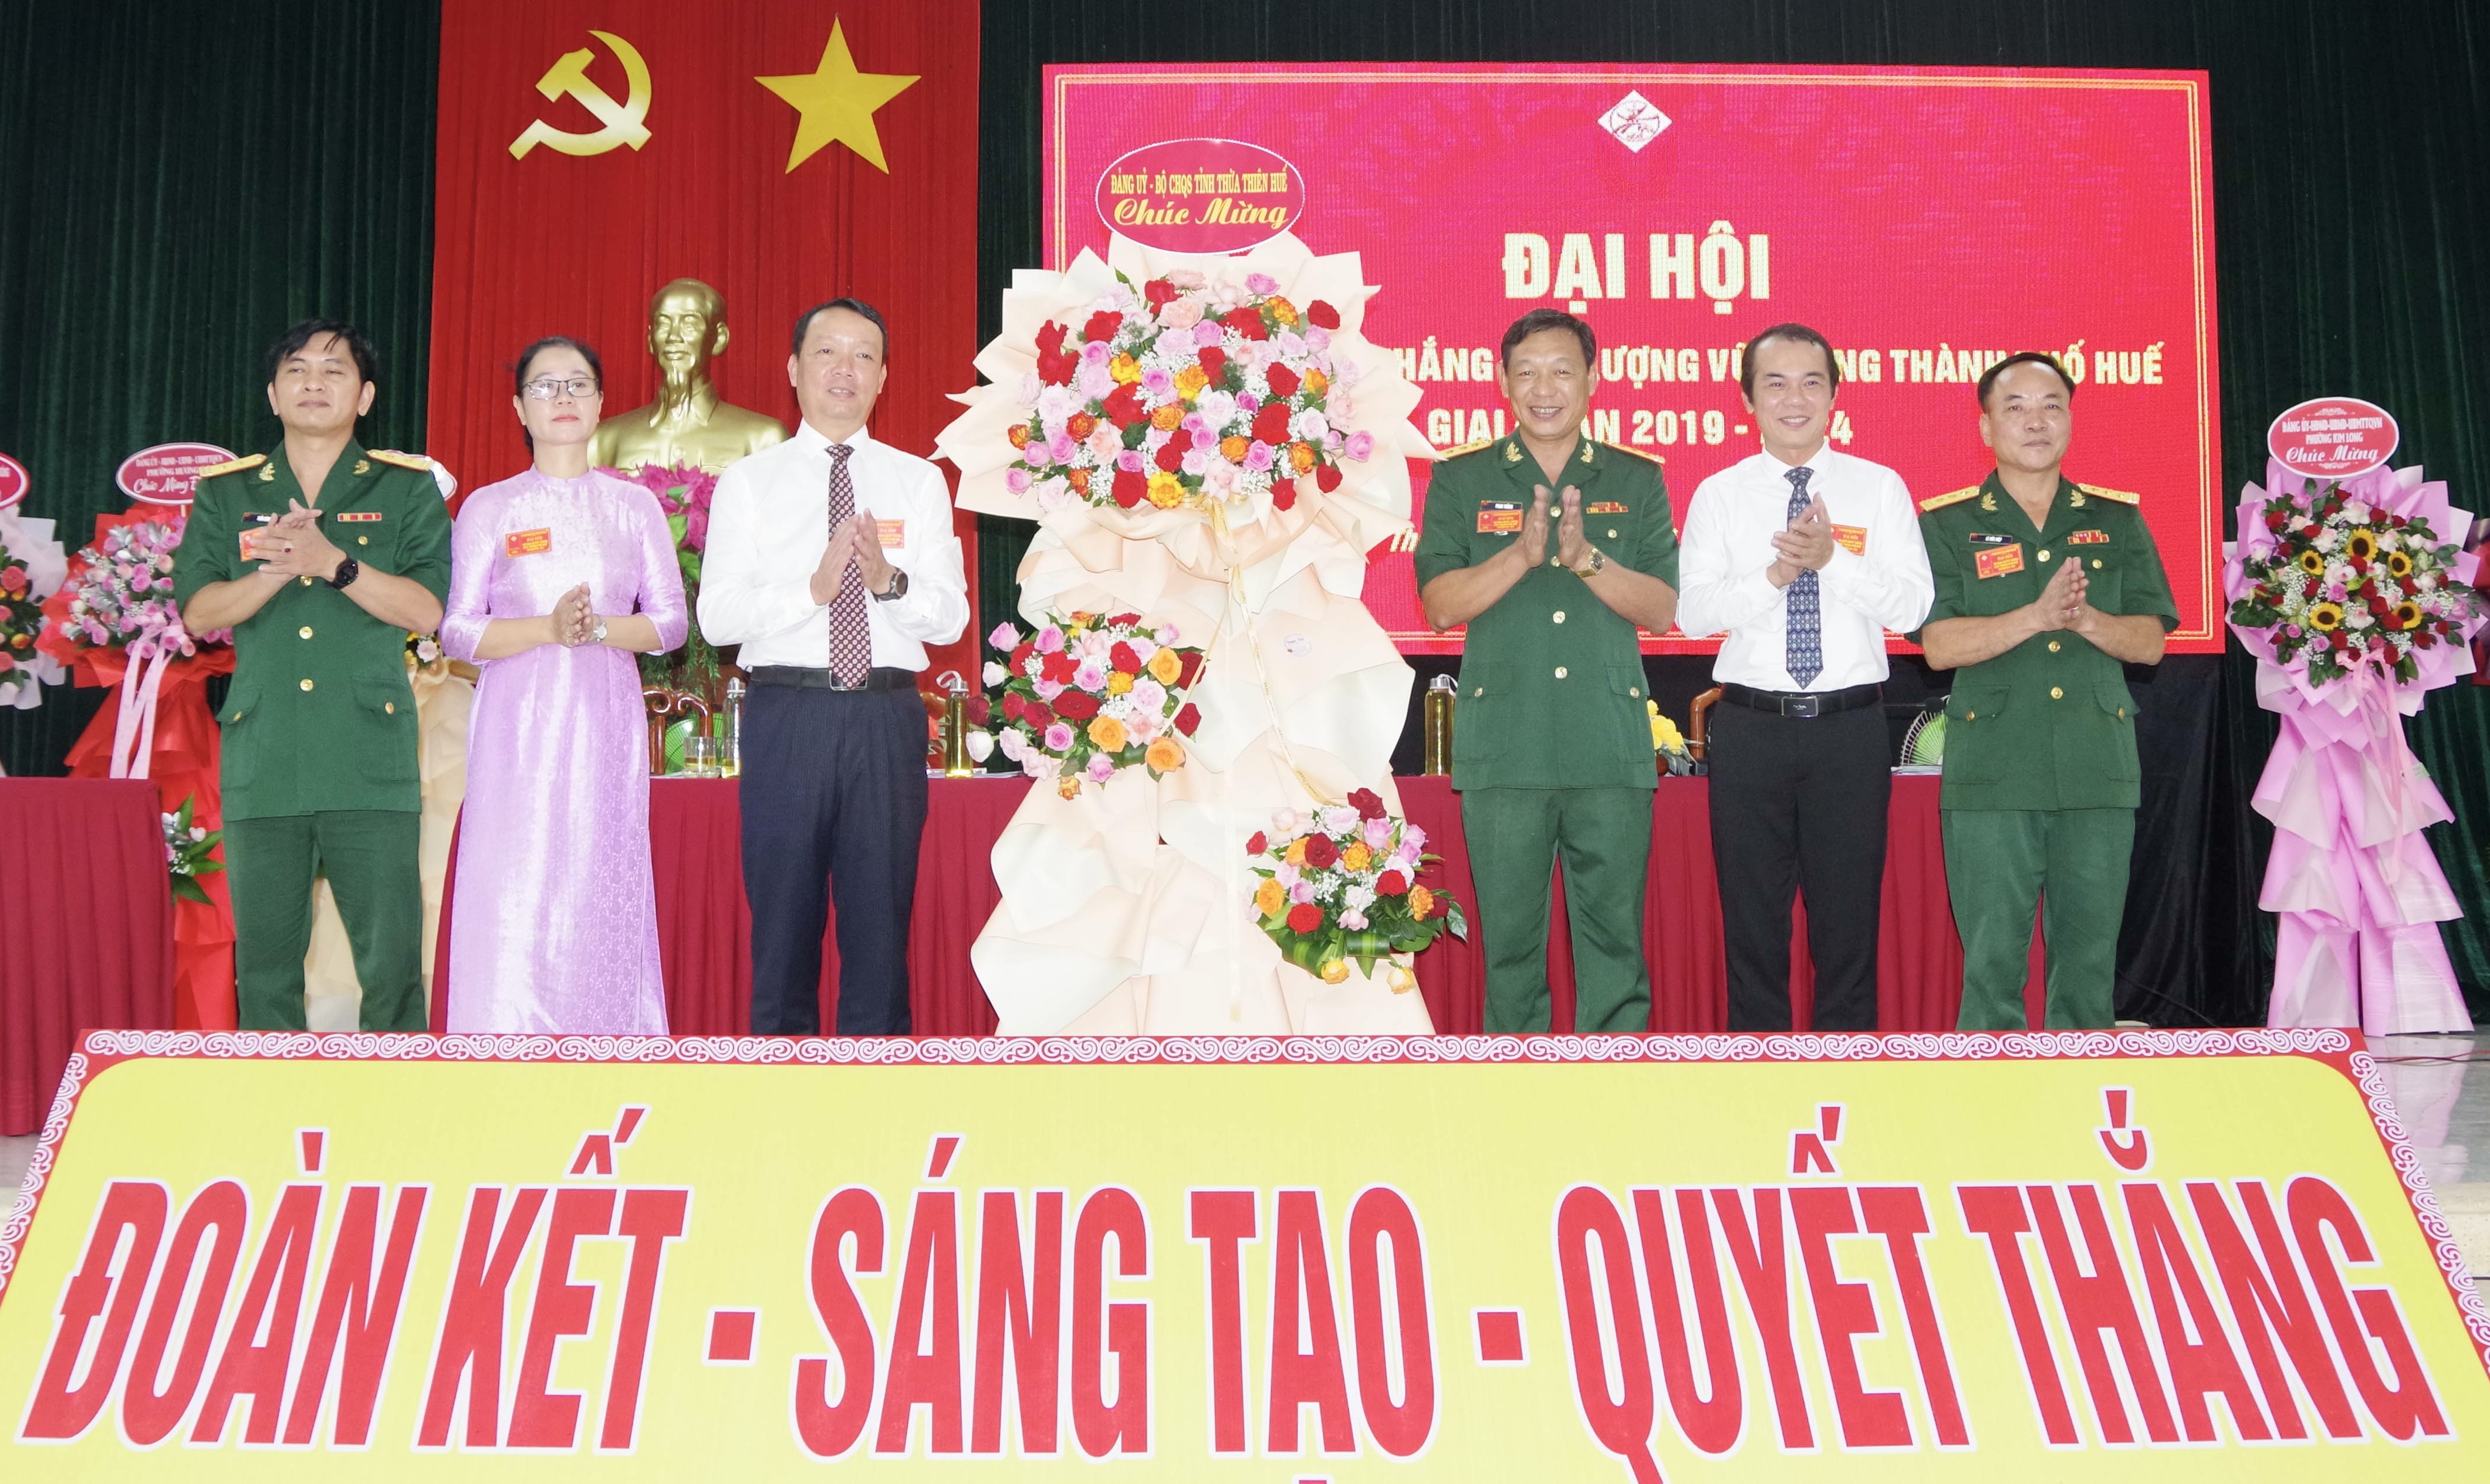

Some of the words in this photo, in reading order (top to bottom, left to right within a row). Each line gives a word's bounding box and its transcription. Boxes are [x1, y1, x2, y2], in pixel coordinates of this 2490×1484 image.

[1111, 167, 1134, 194] ĐẢNG
[1155, 169, 1167, 199] BỘ
[1169, 174, 1192, 199] CHQS
[1194, 167, 1215, 194] TỈNH
[1217, 168, 1241, 194] THỪA
[1242, 168, 1268, 194] THIÊN
[1270, 164, 1288, 192] HUẾ
[1114, 198, 1190, 225] Chúc
[1195, 198, 1289, 229] Mừng
[1502, 232, 1625, 314] ĐẠI
[1649, 220, 1769, 315] HỘI
[1388, 335, 1494, 382] HẮNG
[1597, 345, 1700, 390] ƯỢNG
[2094, 341, 2165, 385] HUẾ
[1427, 408, 1505, 445] GIAI
[1631, 410, 1725, 445] 2019
[2346, 432, 2363, 442] LONG
[2286, 447, 2325, 463] Chúc
[2329, 445, 2378, 463] Mừng
[21, 1131, 428, 1446] ĐOÀN
[416, 1108, 689, 1449] KẾT
[708, 1311, 756, 1361] -
[795, 1137, 1147, 1456] SÁNG
[1477, 1311, 1525, 1360] -
[1557, 1107, 1969, 1484] QUYẾT
[1959, 1090, 2451, 1446] THẮNG
